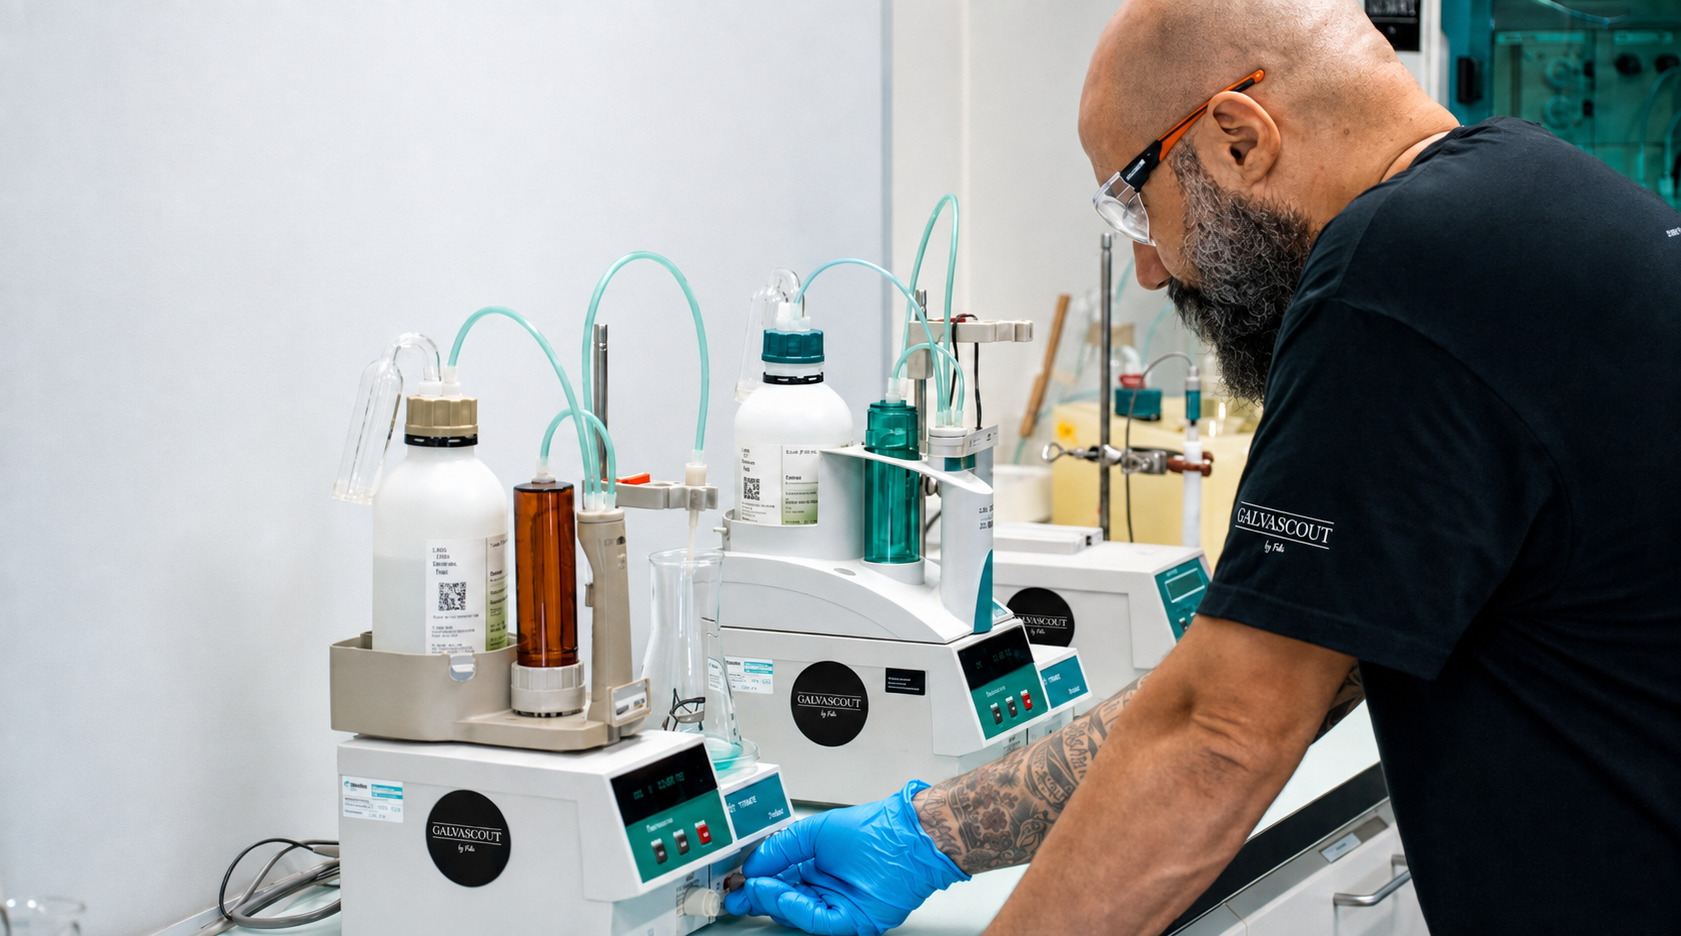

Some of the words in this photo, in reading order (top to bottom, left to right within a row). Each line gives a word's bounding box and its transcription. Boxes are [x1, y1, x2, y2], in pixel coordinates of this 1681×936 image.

[1237, 507, 1333, 544] GALVASCOUT
[797, 694, 862, 708] GALVASCOUT
[432, 825, 502, 842] GALVASCOUT
